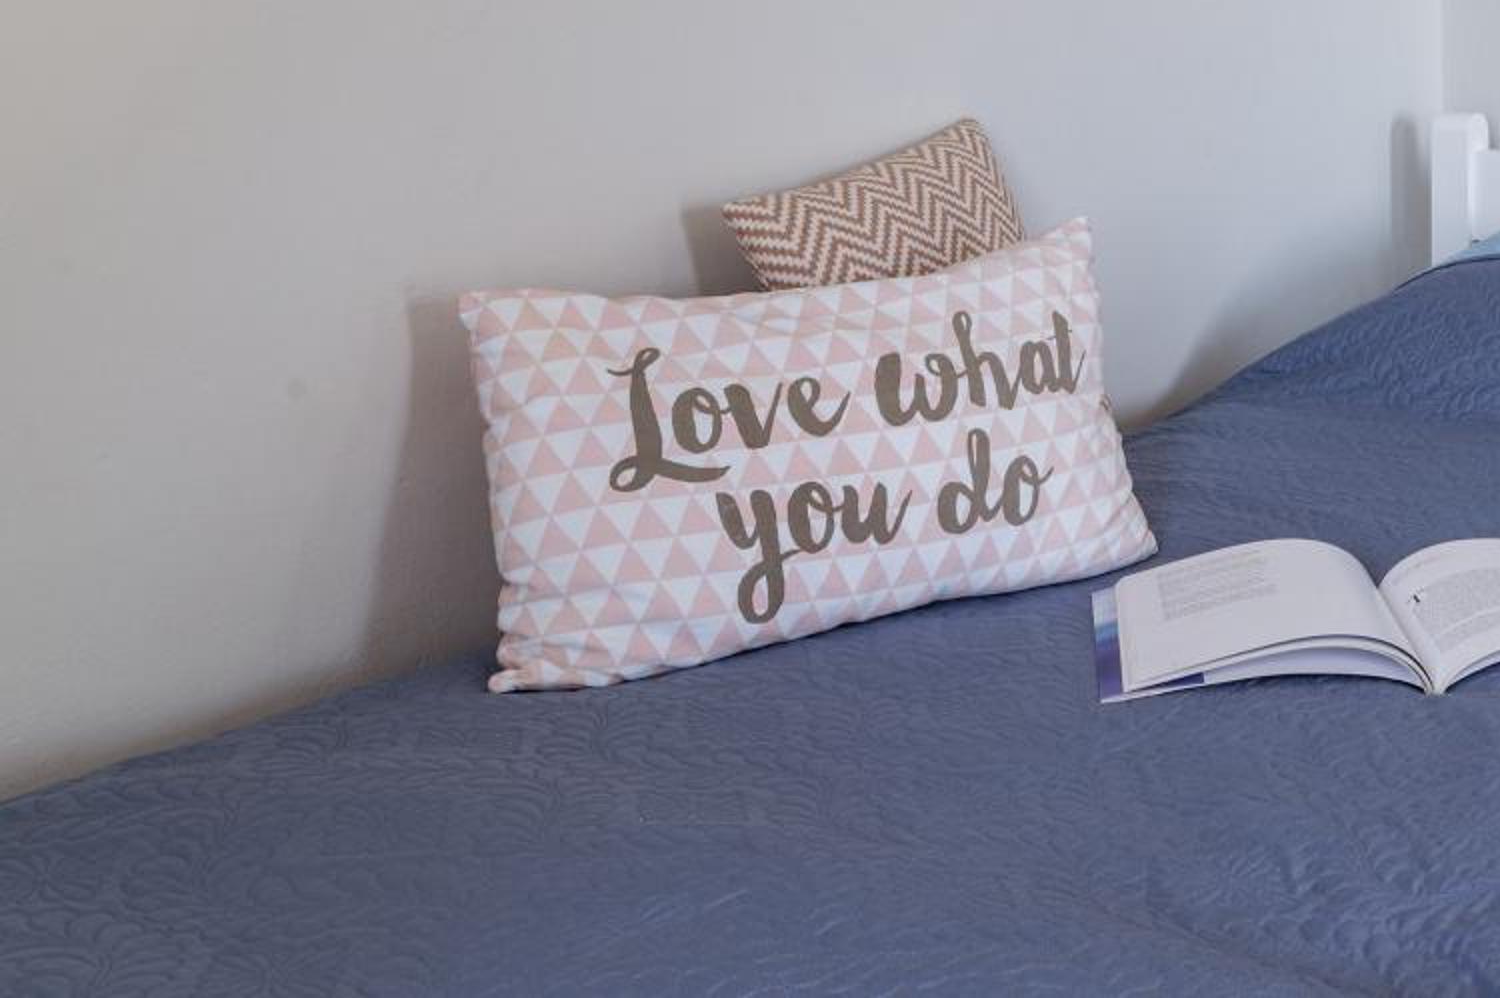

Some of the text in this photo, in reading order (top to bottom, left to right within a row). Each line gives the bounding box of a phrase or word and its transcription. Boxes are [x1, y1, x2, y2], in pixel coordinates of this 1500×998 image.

[607, 310, 1086, 492] Love what
[717, 428, 1054, 624] you do
